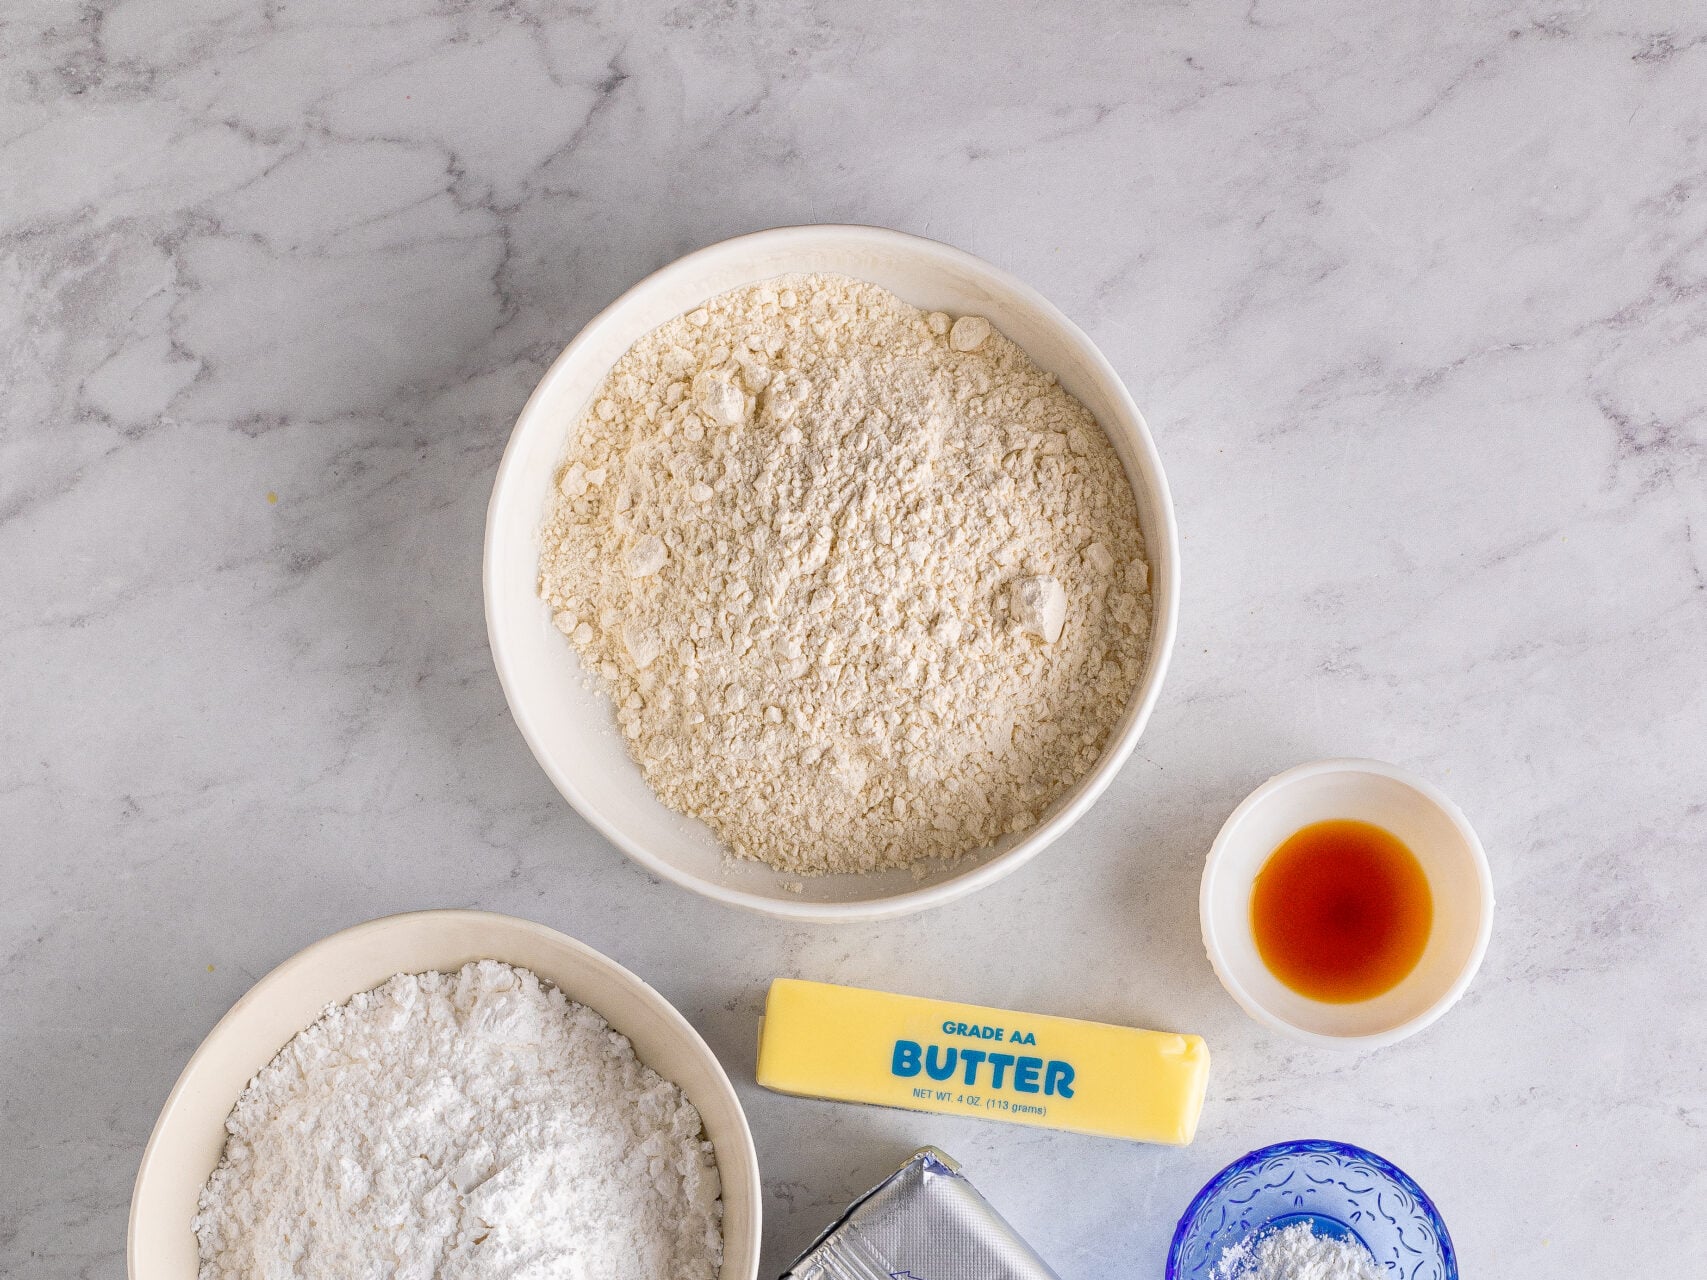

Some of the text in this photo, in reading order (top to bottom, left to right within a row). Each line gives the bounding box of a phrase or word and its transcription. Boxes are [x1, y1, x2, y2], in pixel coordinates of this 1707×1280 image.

[942, 1021, 1036, 1046] GRADE AA
[891, 1039, 1076, 1099] BUTTER
[912, 1088, 933, 1099] NET
[957, 1094, 964, 1103] 4
[986, 1098, 1009, 1110] (113
[1011, 1103, 1047, 1117] grams)
